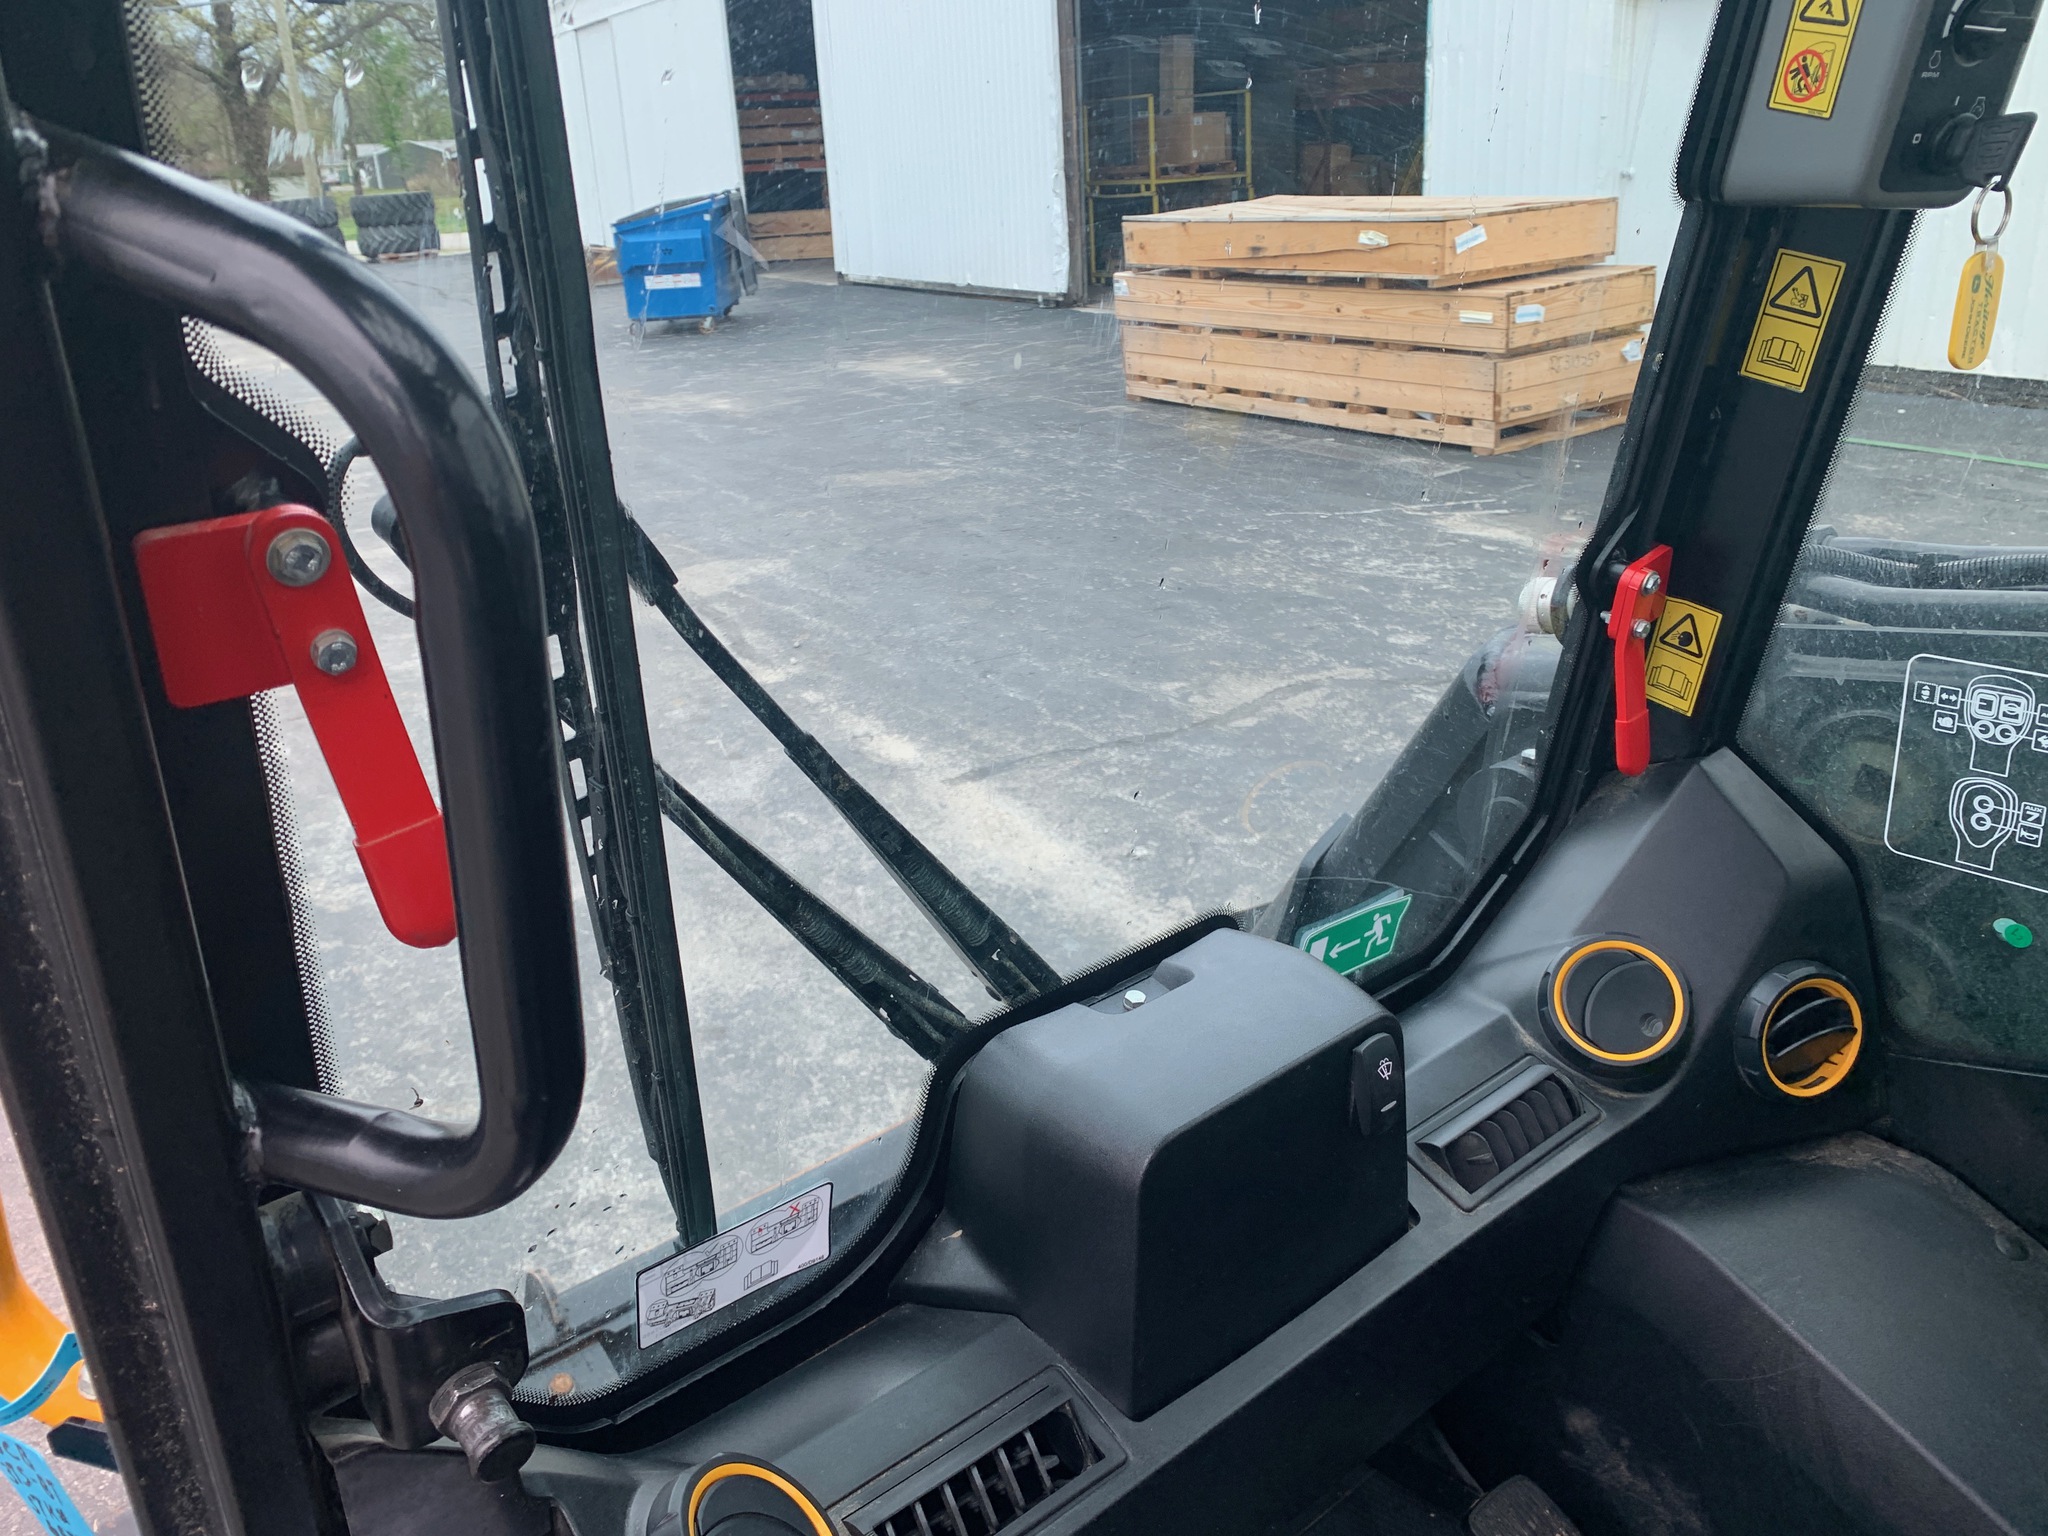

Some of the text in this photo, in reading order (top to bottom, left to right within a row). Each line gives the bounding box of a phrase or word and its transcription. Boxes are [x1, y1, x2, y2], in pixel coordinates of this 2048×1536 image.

[1979, 272, 1995, 350] Heritage
[1967, 303, 1983, 364] TRACTOR
[2024, 805, 2043, 814] AUX
[2026, 810, 2041, 822] 7
